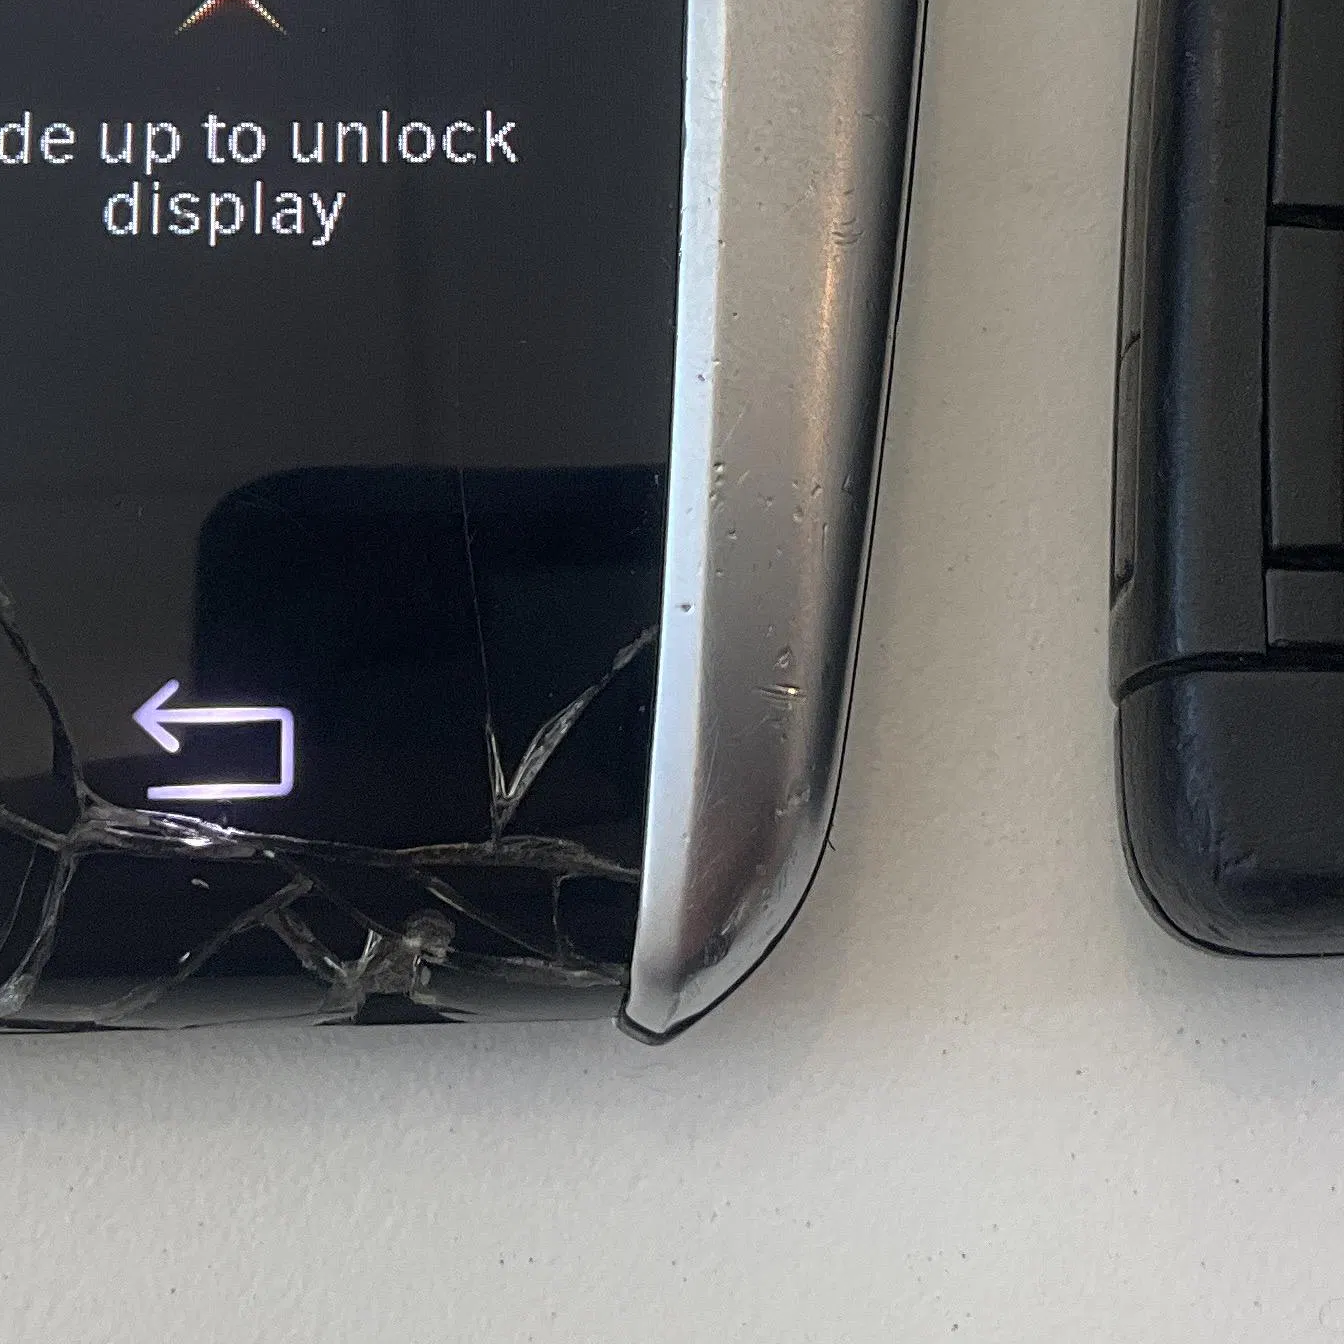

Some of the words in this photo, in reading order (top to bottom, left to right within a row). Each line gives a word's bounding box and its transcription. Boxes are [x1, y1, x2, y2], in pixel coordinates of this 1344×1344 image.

[99, 121, 182, 175] up
[200, 112, 266, 164] to
[291, 109, 520, 164] unlock
[102, 179, 348, 247] display
